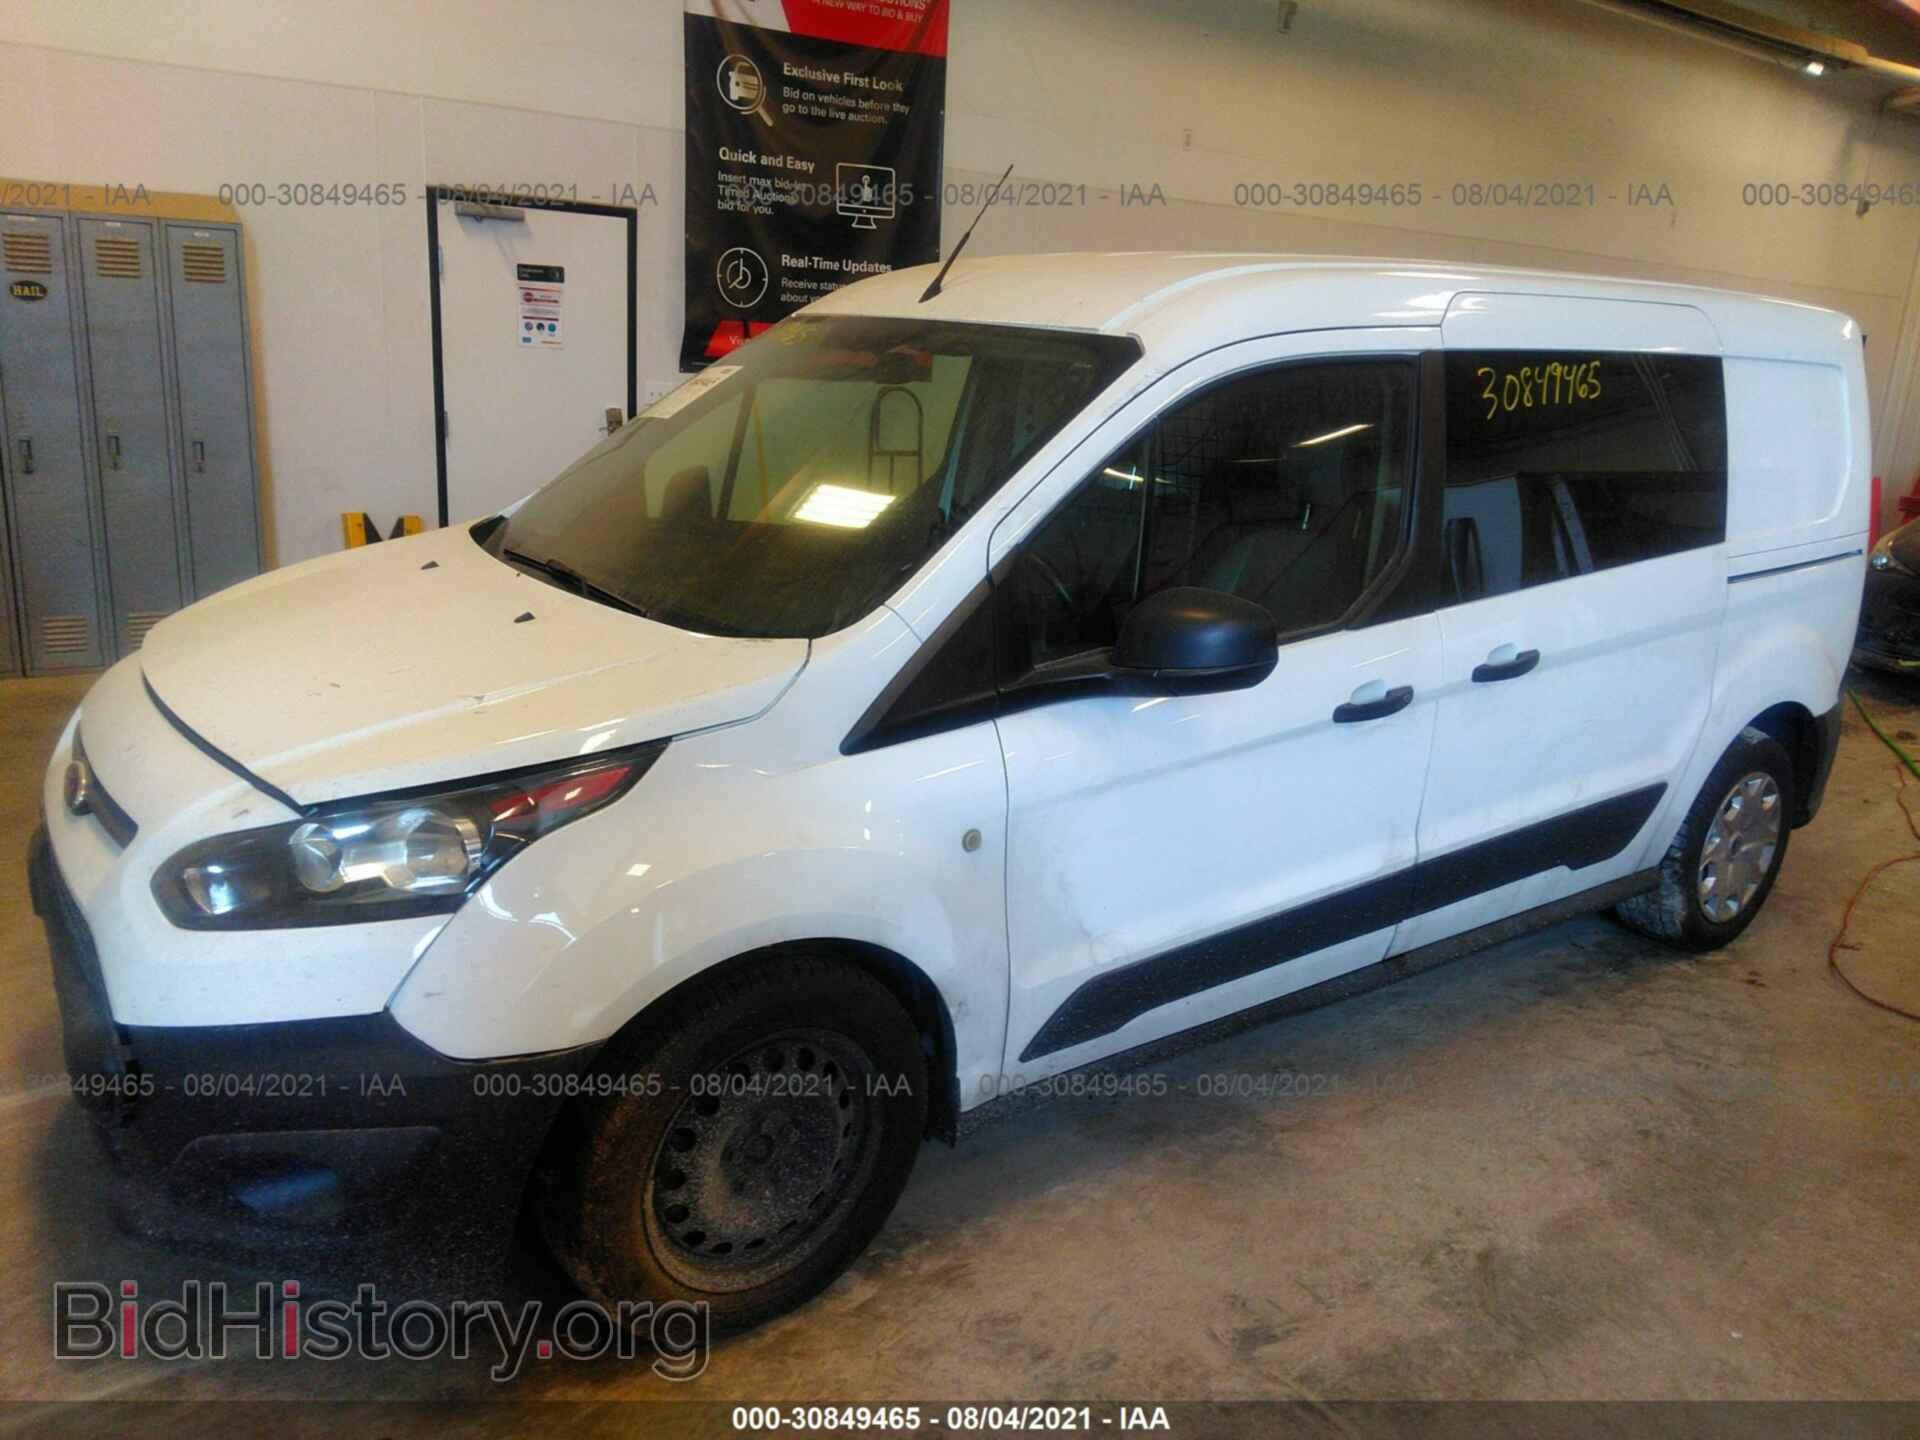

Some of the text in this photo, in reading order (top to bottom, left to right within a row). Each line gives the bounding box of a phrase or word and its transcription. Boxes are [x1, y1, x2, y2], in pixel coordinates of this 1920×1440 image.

[784, 62, 904, 91] Exclusive First Look
[783, 87, 911, 115] Bid on vehicles before they
[782, 103, 796, 114] go
[798, 104, 808, 114] to
[810, 106, 827, 117] the
[828, 108, 846, 120] live
[719, 147, 815, 174] Quick and Easy
[718, 170, 746, 184] Insert
[749, 176, 772, 186] max
[717, 200, 775, 215] bid for you.
[782, 254, 893, 274] Real-Time Updates
[781, 277, 818, 290] Receive
[1478, 360, 1601, 419] 30849465
